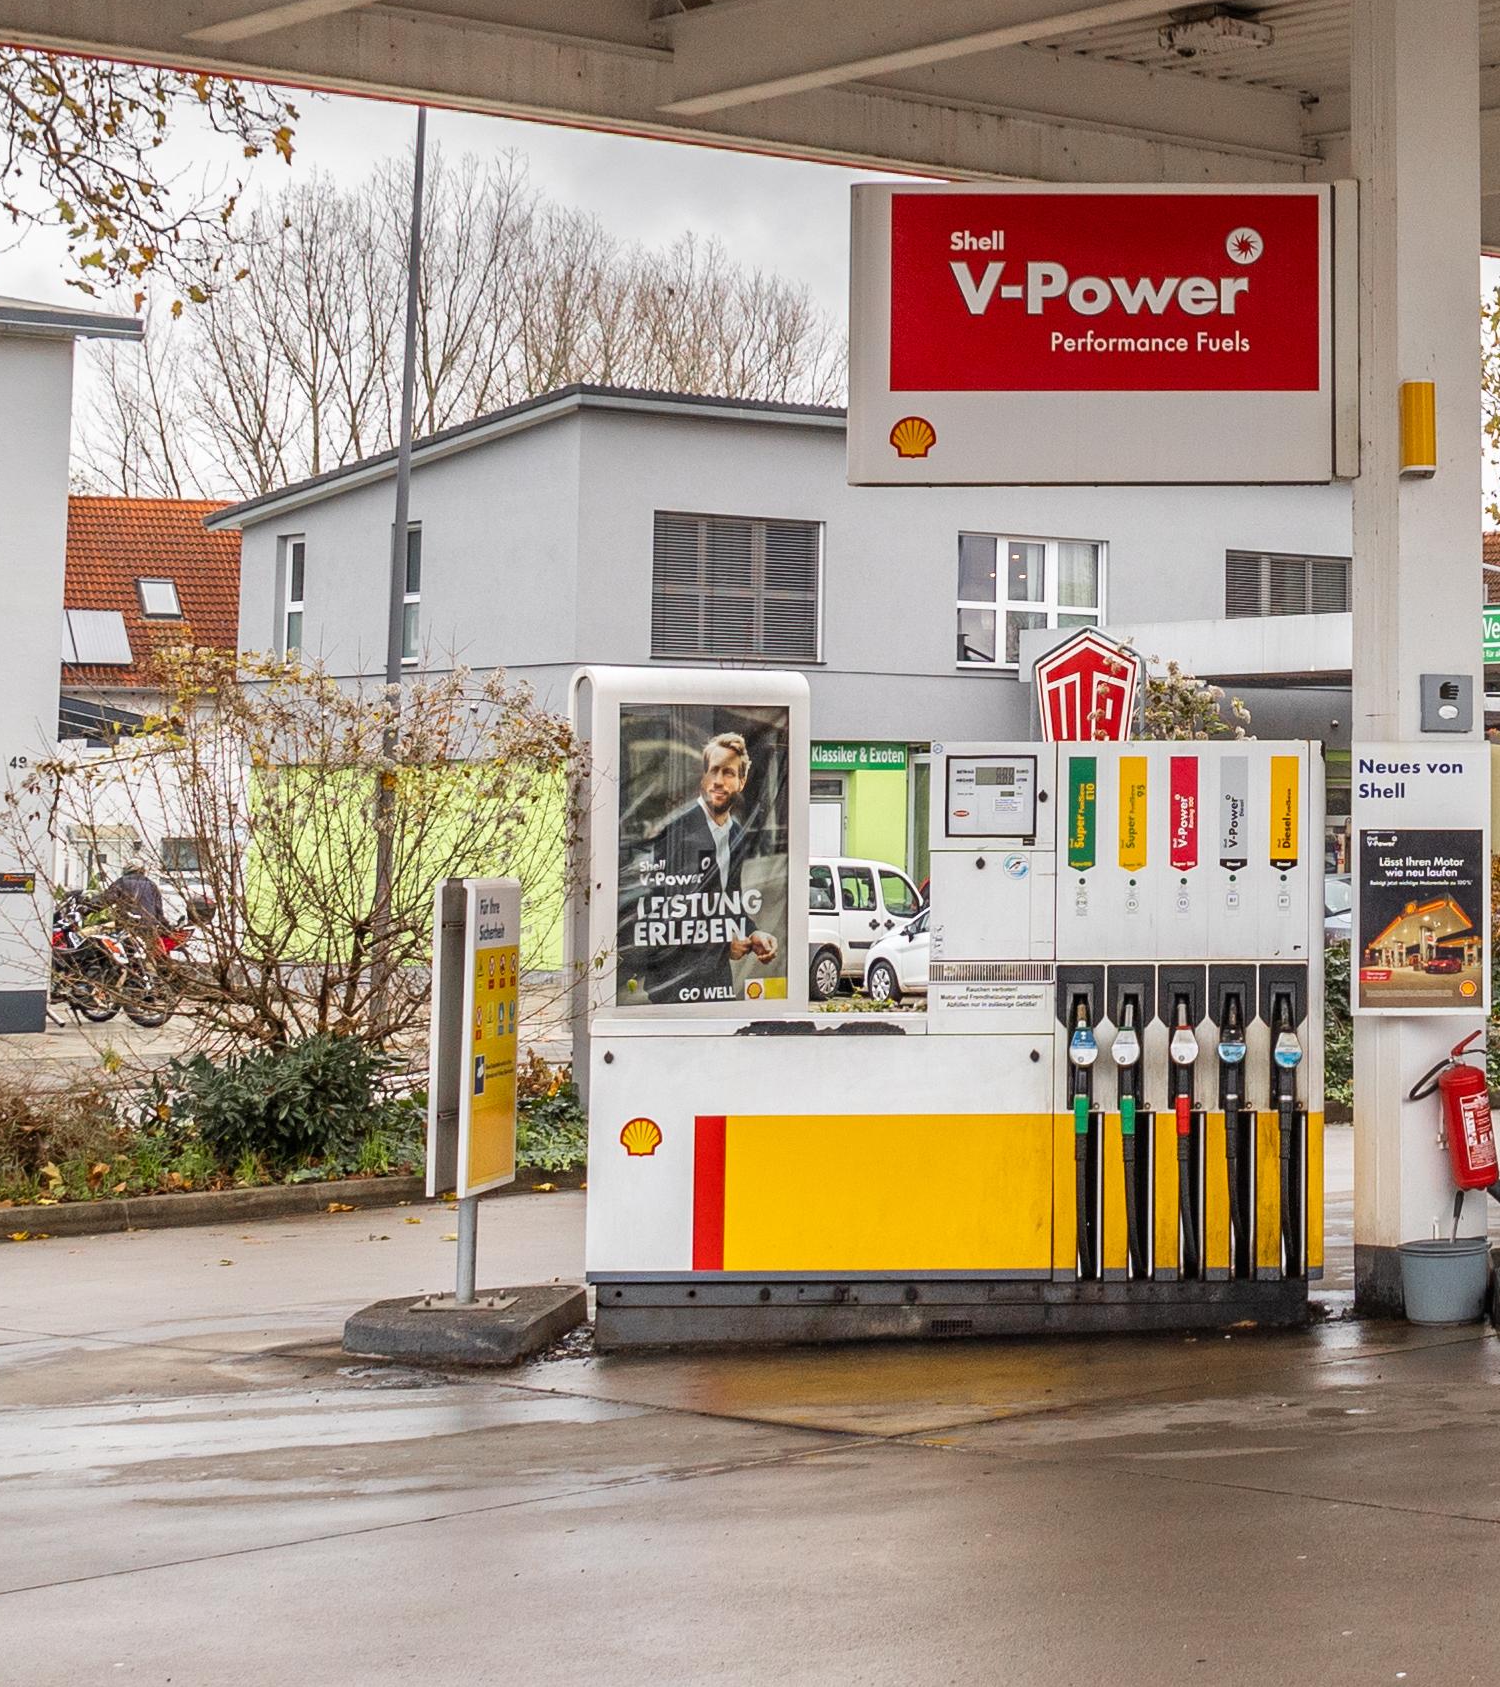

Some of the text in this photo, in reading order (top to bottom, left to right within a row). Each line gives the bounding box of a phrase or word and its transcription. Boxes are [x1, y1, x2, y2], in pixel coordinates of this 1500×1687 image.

[950, 230, 1005, 251] Shell
[949, 261, 1249, 315] V-Power
[1051, 330, 1250, 352] Performance Fuels
[811, 745, 905, 763] Klassiker & Exoten
[1358, 759, 1464, 775] Neues von
[1086, 782, 1095, 801] E10
[1137, 784, 1145, 797] 95
[1358, 782, 1405, 799] Shell
[1074, 813, 1087, 849] Super
[1125, 815, 1137, 849] Super
[1177, 801, 1189, 848] V-Power
[1227, 798, 1240, 848] V-Power
[1282, 817, 1292, 849] Diesel
[639, 859, 666, 873] Shell
[1379, 856, 1465, 867] Lässt Ihren Motor
[639, 872, 705, 887] V-Power
[1385, 866, 1458, 877] wie neu laufen
[489, 896, 500, 914] Ihre
[636, 888, 763, 921] LEISTUNG
[633, 916, 749, 948] ERLEBEN
[678, 985, 736, 1002] GO WELL
